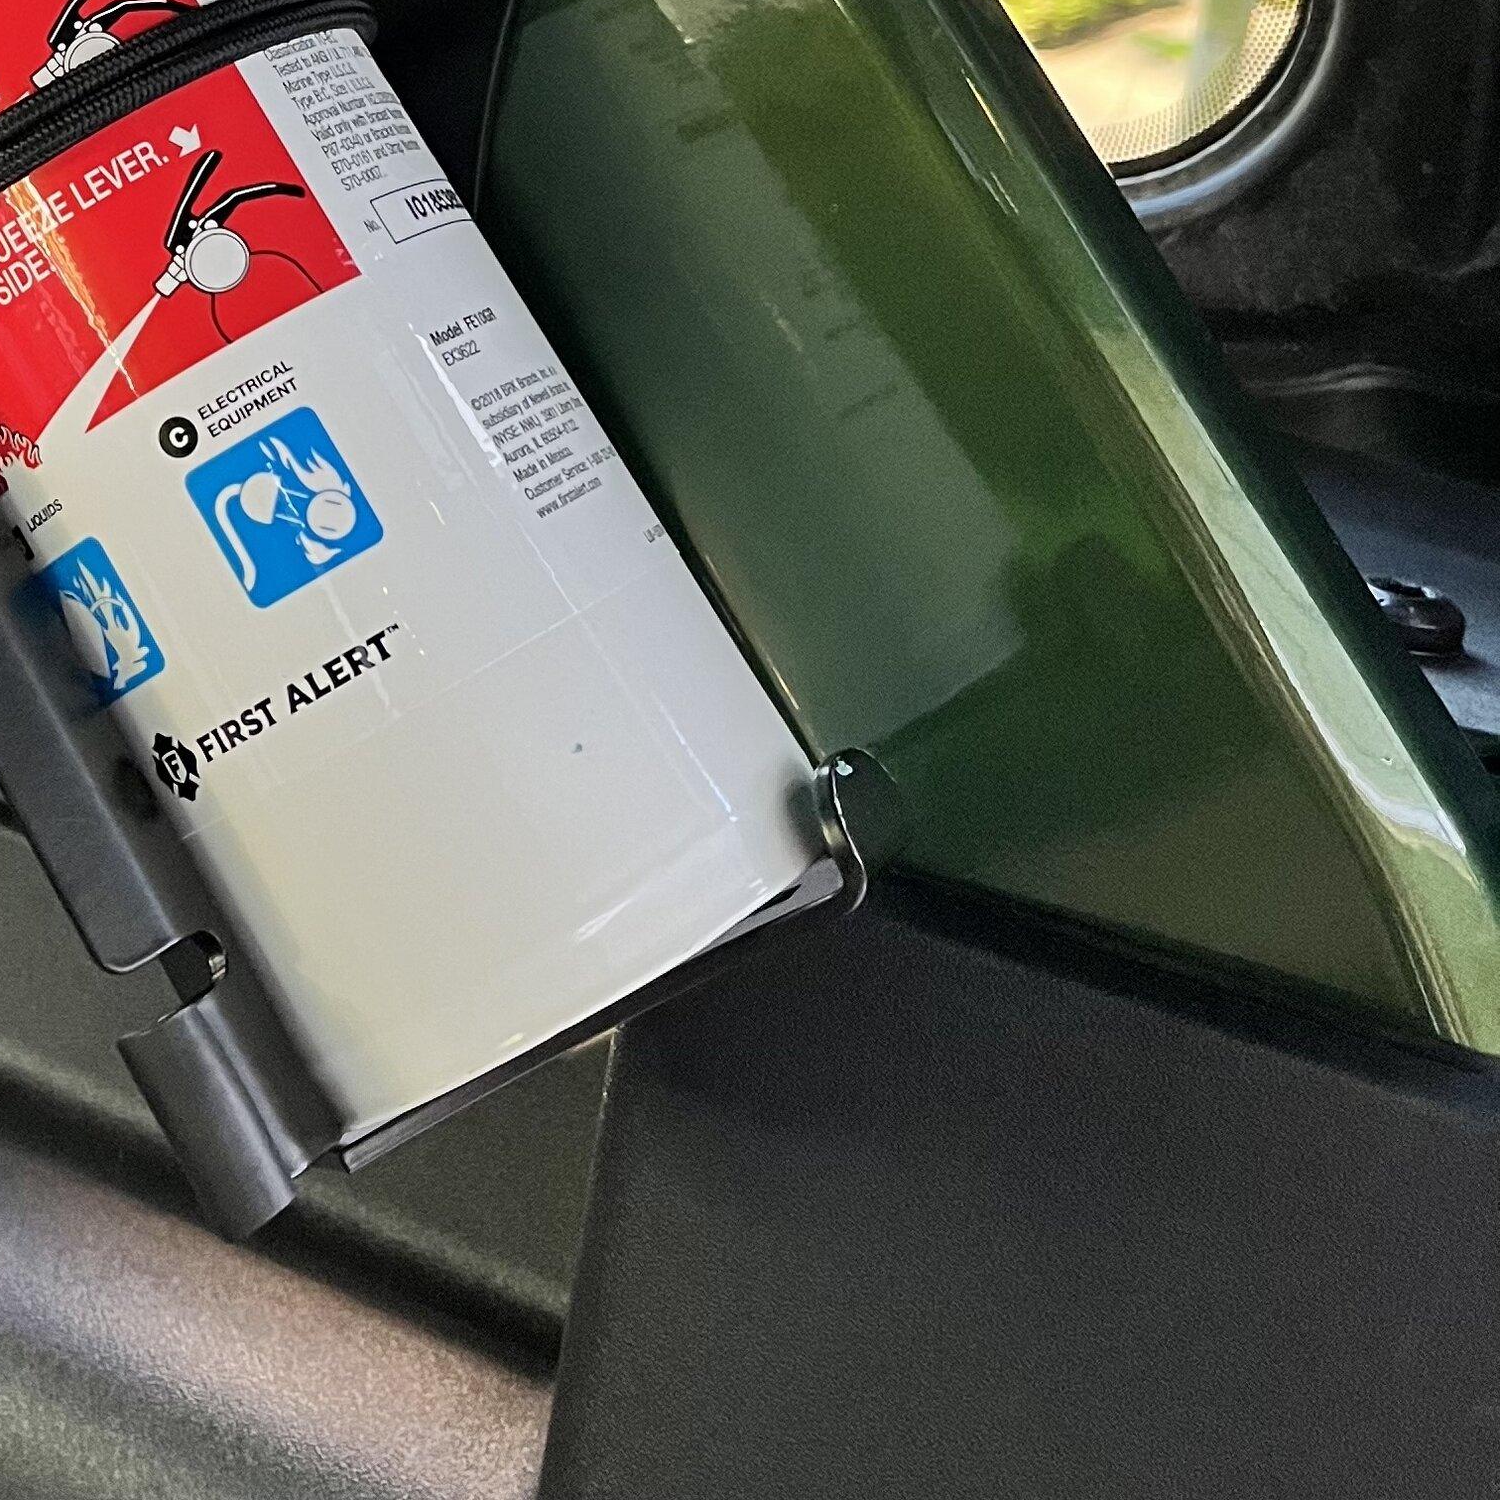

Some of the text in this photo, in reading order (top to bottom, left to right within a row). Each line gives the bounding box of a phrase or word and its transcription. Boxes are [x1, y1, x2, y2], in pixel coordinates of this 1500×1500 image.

[272, 58, 303, 78] Tested
[283, 76, 314, 95] Marine
[290, 95, 316, 111] Type
[303, 105, 340, 126] Approval
[310, 125, 335, 141] Valid
[69, 140, 170, 212] LEVER.
[429, 320, 464, 347] Model
[197, 358, 294, 421] ELECTRICAL
[207, 377, 299, 438] EQUIPMENT
[482, 401, 524, 430] subsidiary
[513, 463, 539, 483] Made
[524, 473, 563, 500] Customer
[25, 498, 64, 533] LIQUIDS
[196, 697, 278, 763] FIRST
